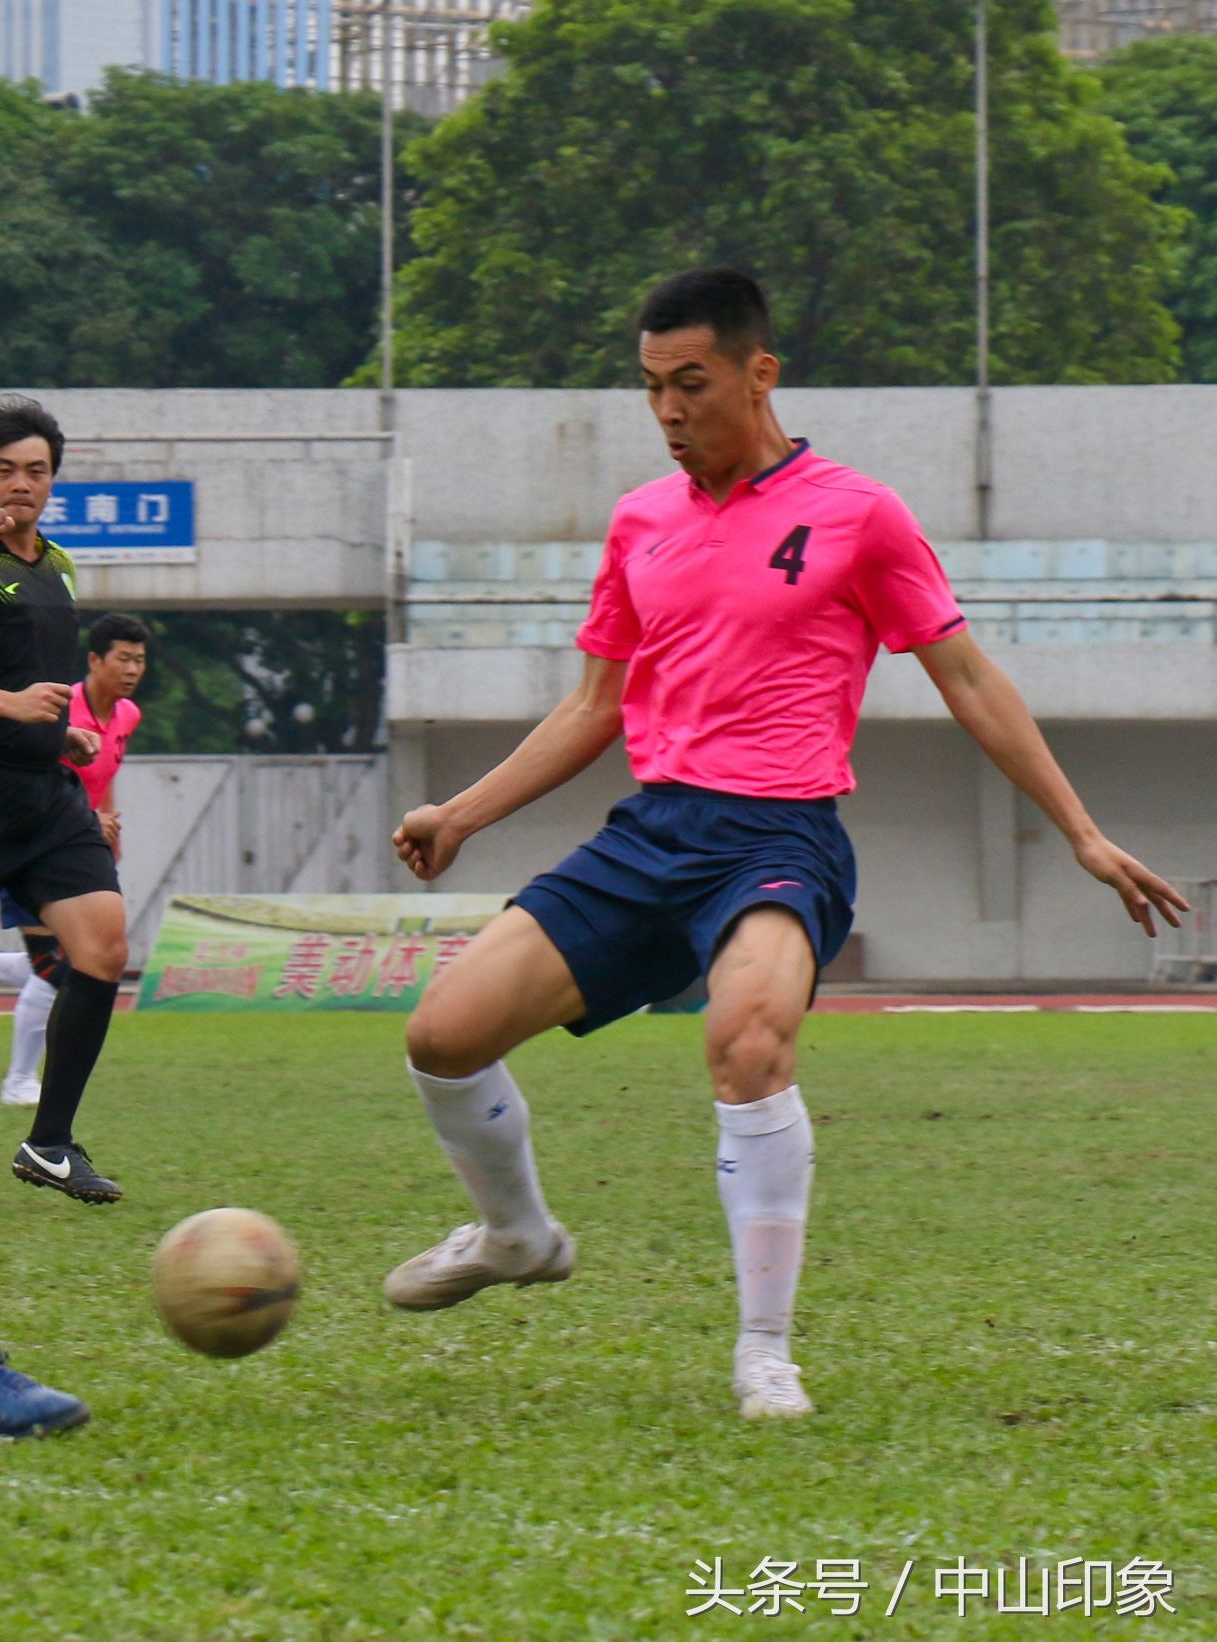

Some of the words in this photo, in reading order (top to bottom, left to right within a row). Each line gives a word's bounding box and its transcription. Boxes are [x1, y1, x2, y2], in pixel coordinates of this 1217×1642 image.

[38, 493, 170, 524] 东南门
[768, 525, 812, 586] 4
